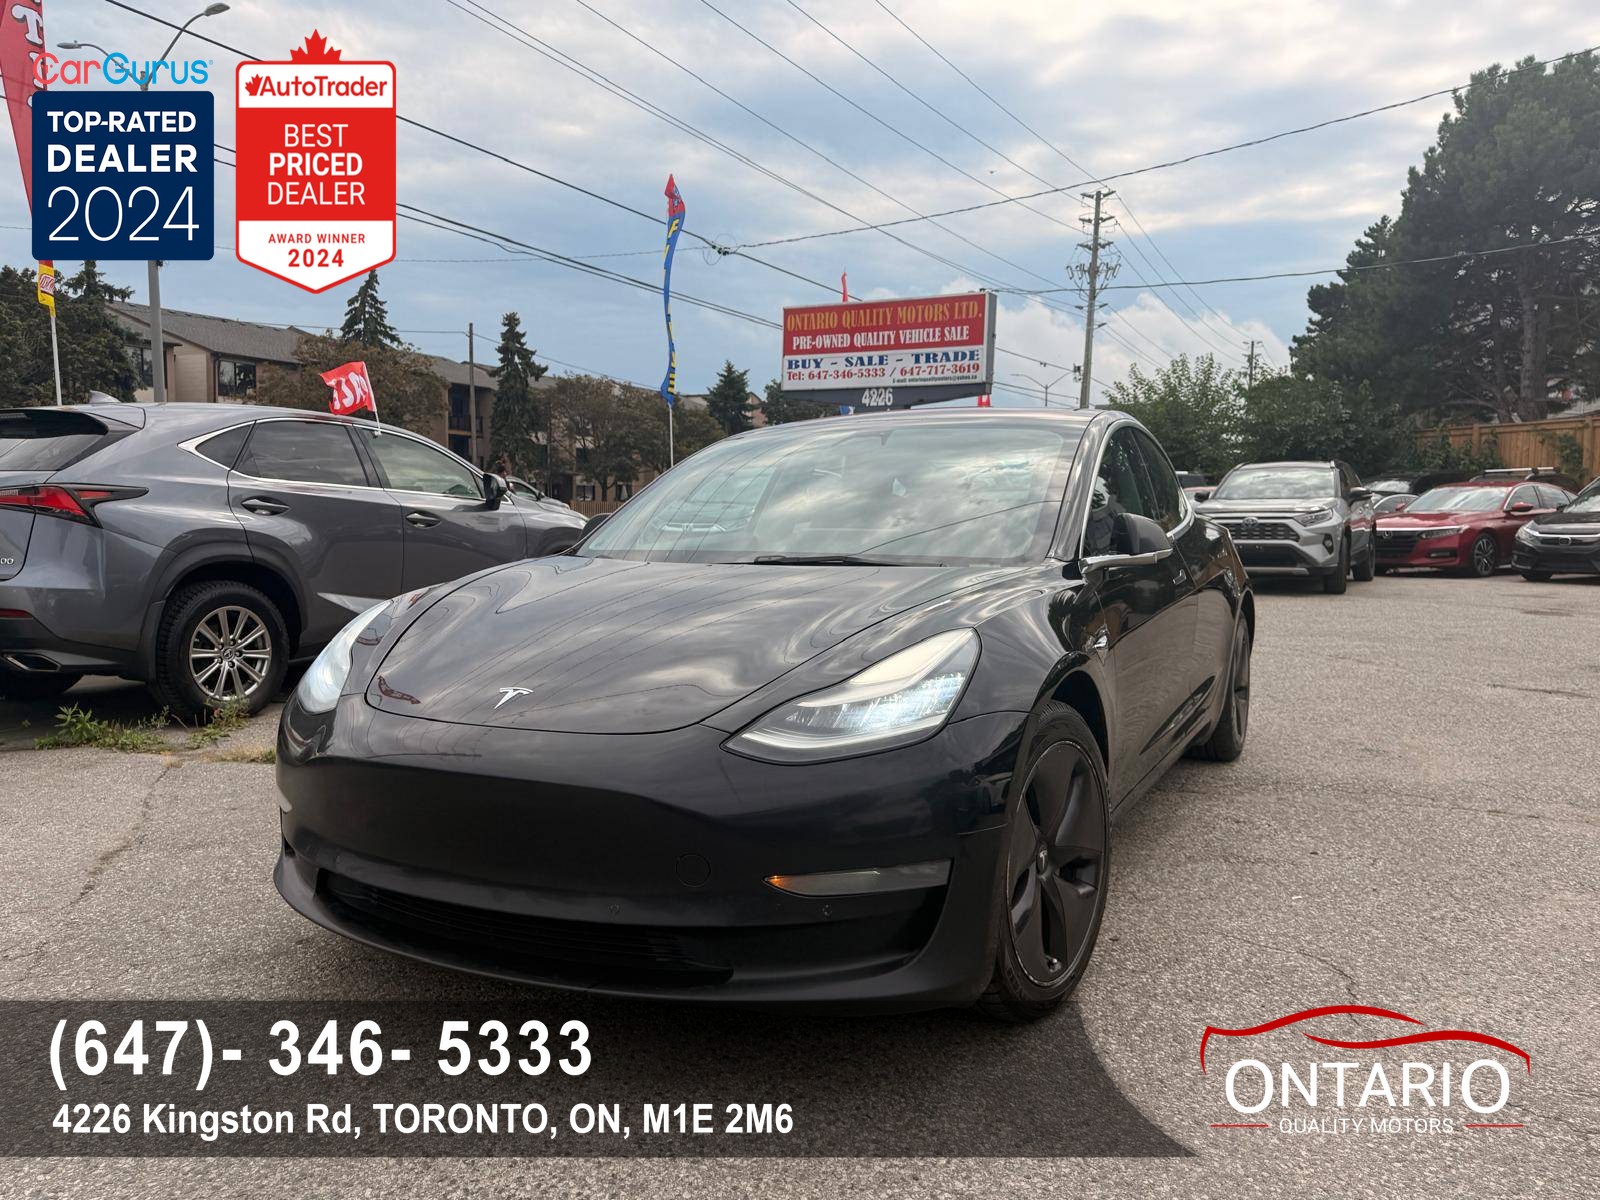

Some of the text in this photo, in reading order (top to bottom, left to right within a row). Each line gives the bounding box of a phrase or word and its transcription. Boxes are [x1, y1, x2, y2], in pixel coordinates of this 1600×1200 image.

[787, 300, 982, 332] ONTARIO QUALITY MOTORS LTD.
[792, 325, 970, 350] PRE-OWNED QUALITY VEHICLE SALE
[787, 358, 823, 370] BUY
[844, 355, 889, 368] SALE
[911, 349, 980, 364] TRADE
[787, 371, 805, 381] Tel:
[808, 368, 885, 380] 647-346-5333
[899, 362, 980, 376] 647-717-3619
[861, 388, 894, 407] 4226
